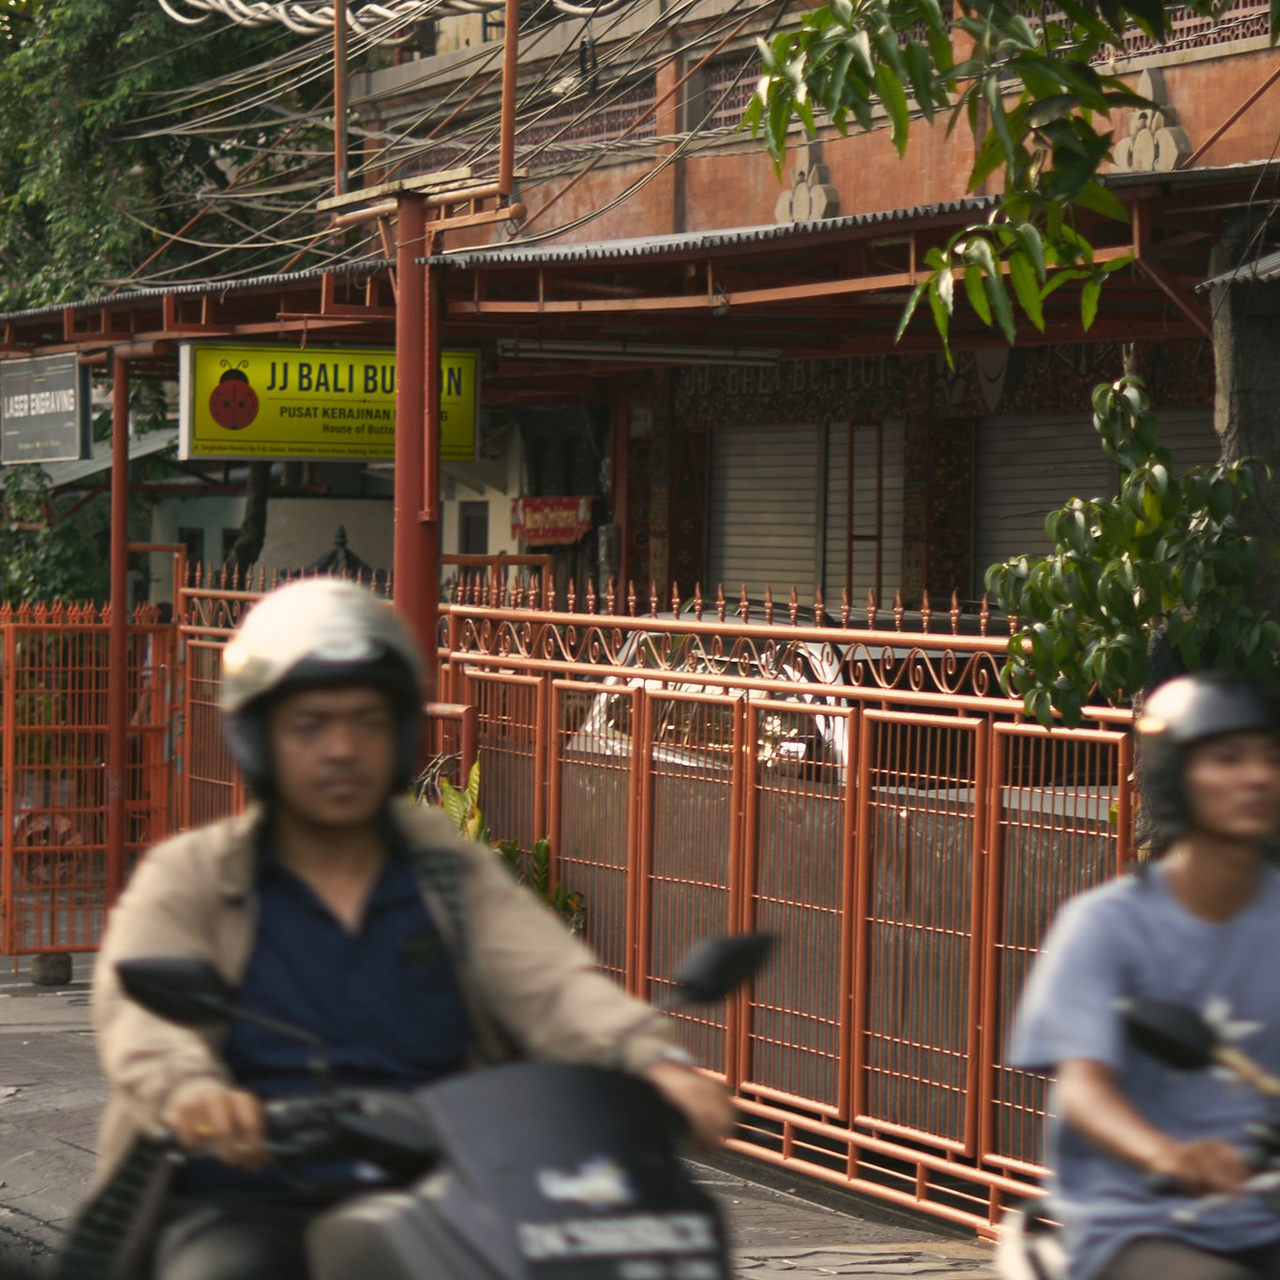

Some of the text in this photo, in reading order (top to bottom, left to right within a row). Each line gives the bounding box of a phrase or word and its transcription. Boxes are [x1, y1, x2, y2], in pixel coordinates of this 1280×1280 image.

[266, 362, 289, 391] JJ
[298, 363, 354, 393] BALI
[4, 388, 75, 418] LASER ENGRAVING
[280, 406, 318, 419] PUSAT
[322, 407, 391, 420] KERAJINAN
[322, 424, 353, 434] House
[355, 424, 365, 435] of
